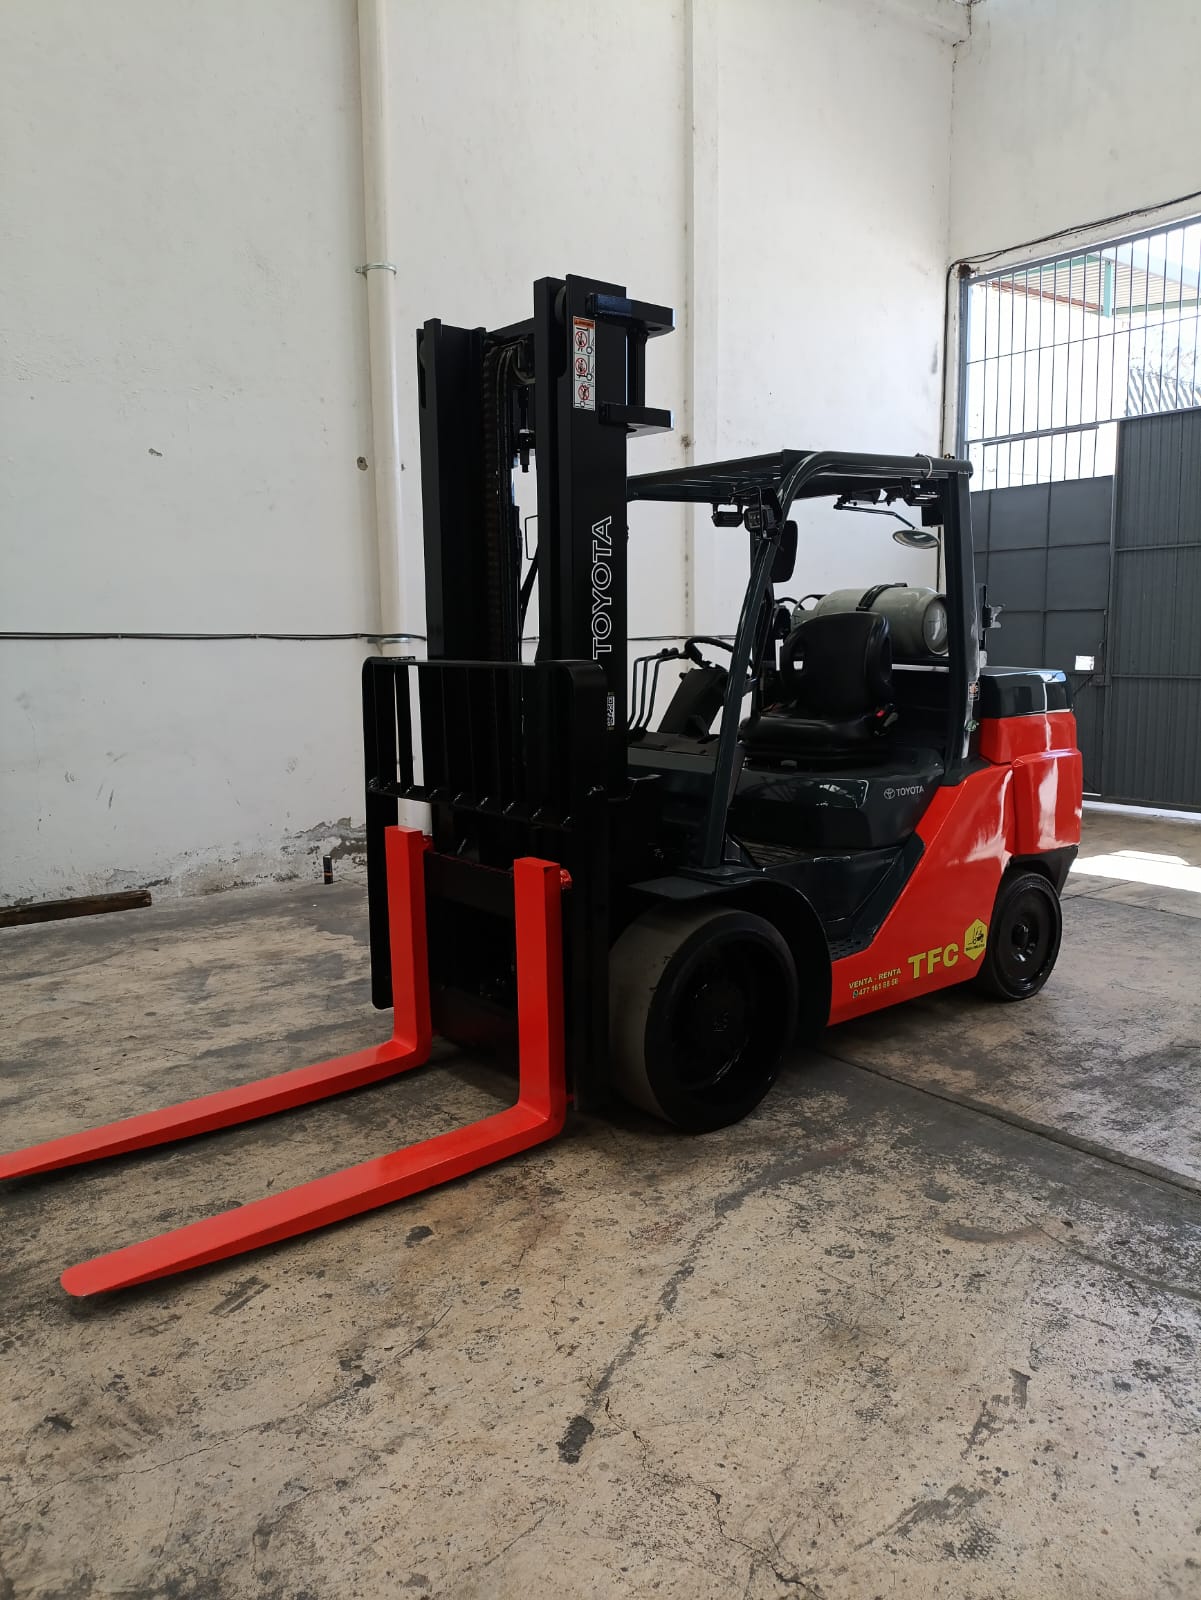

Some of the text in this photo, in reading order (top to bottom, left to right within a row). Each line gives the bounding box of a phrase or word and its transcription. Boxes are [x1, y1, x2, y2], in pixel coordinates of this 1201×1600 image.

[591, 515, 612, 661] TOYOTA
[895, 784, 925, 797] TOYOTA
[908, 943, 959, 979] TFC
[849, 977, 872, 989] VENTA
[878, 968, 901, 980] RENTA
